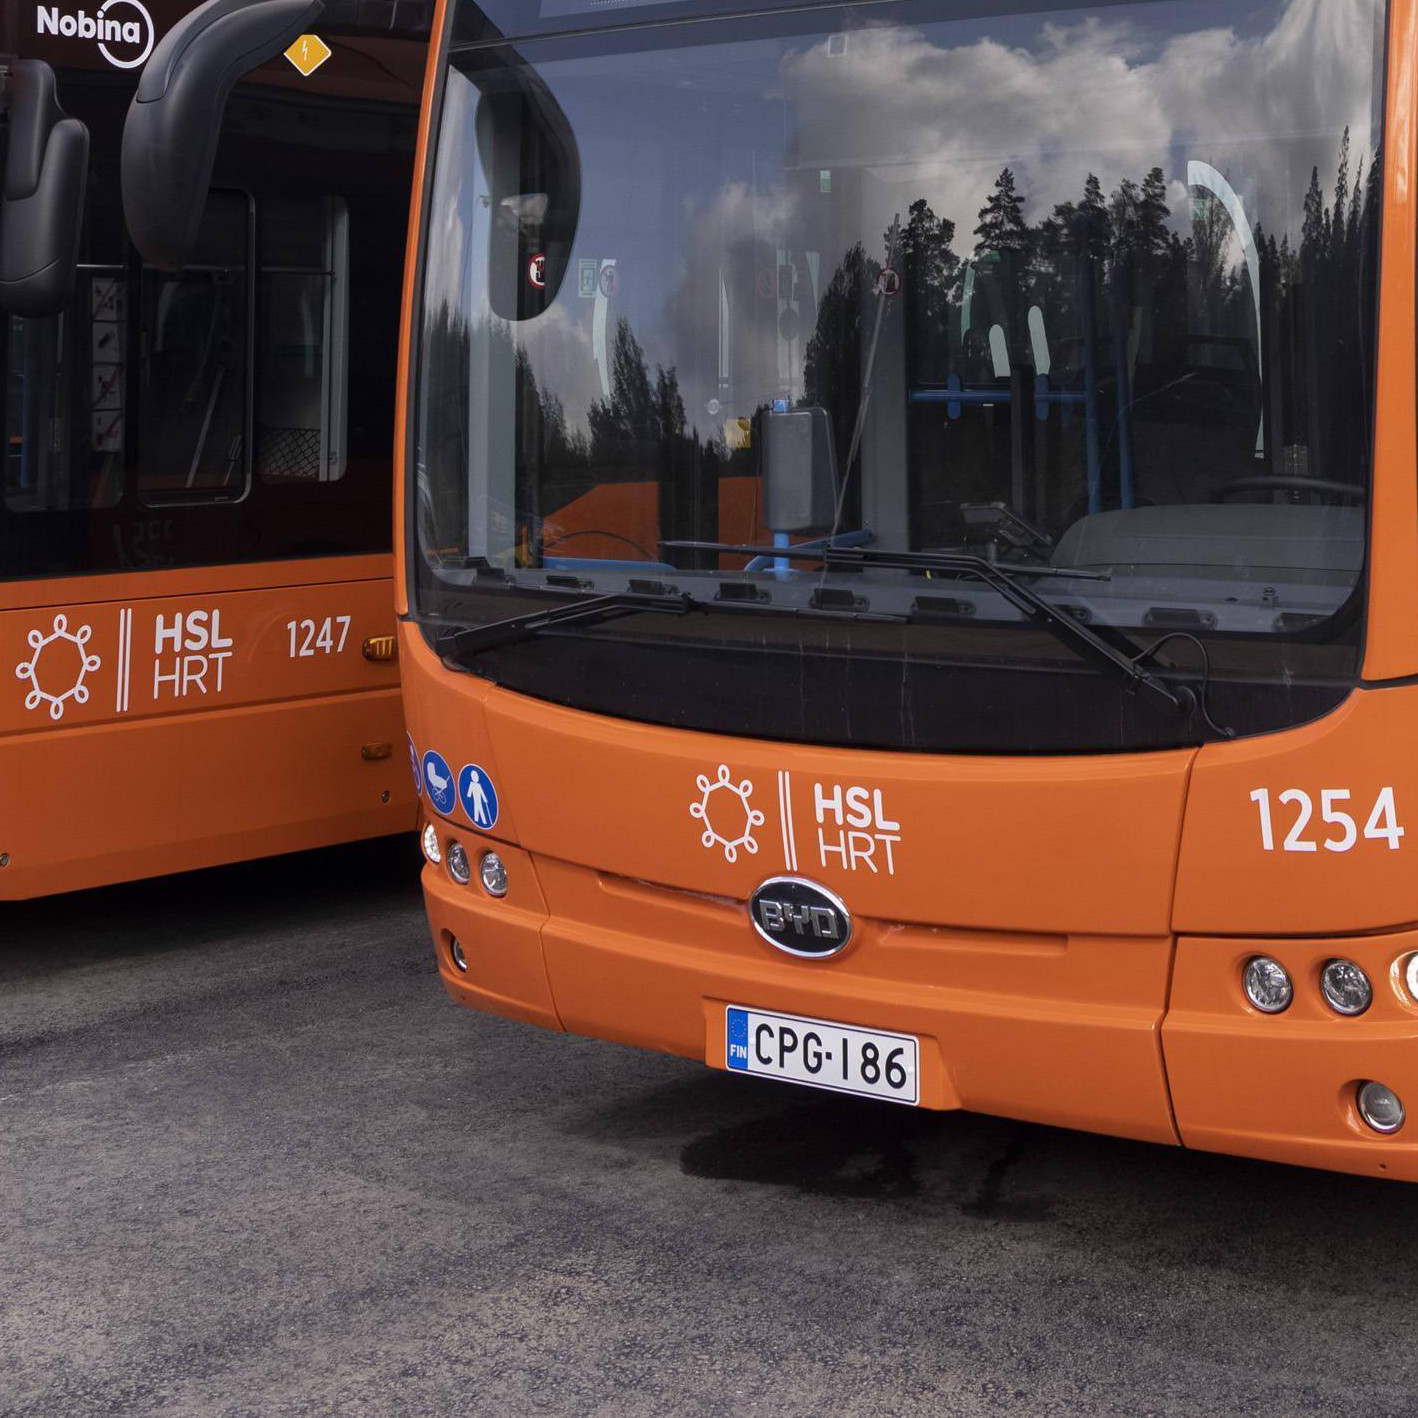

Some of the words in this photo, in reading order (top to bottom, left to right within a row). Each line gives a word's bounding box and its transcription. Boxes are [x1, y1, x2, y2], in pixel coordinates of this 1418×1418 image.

[37, 5, 140, 43] Nobina
[155, 608, 233, 655] HSL
[287, 615, 351, 658] 1247
[153, 651, 233, 699] HRT
[814, 783, 900, 831] HSL
[1250, 786, 1405, 852] 1254
[818, 827, 901, 875] HRT
[759, 899, 839, 940] BYD
[730, 1044, 747, 1059] FIN
